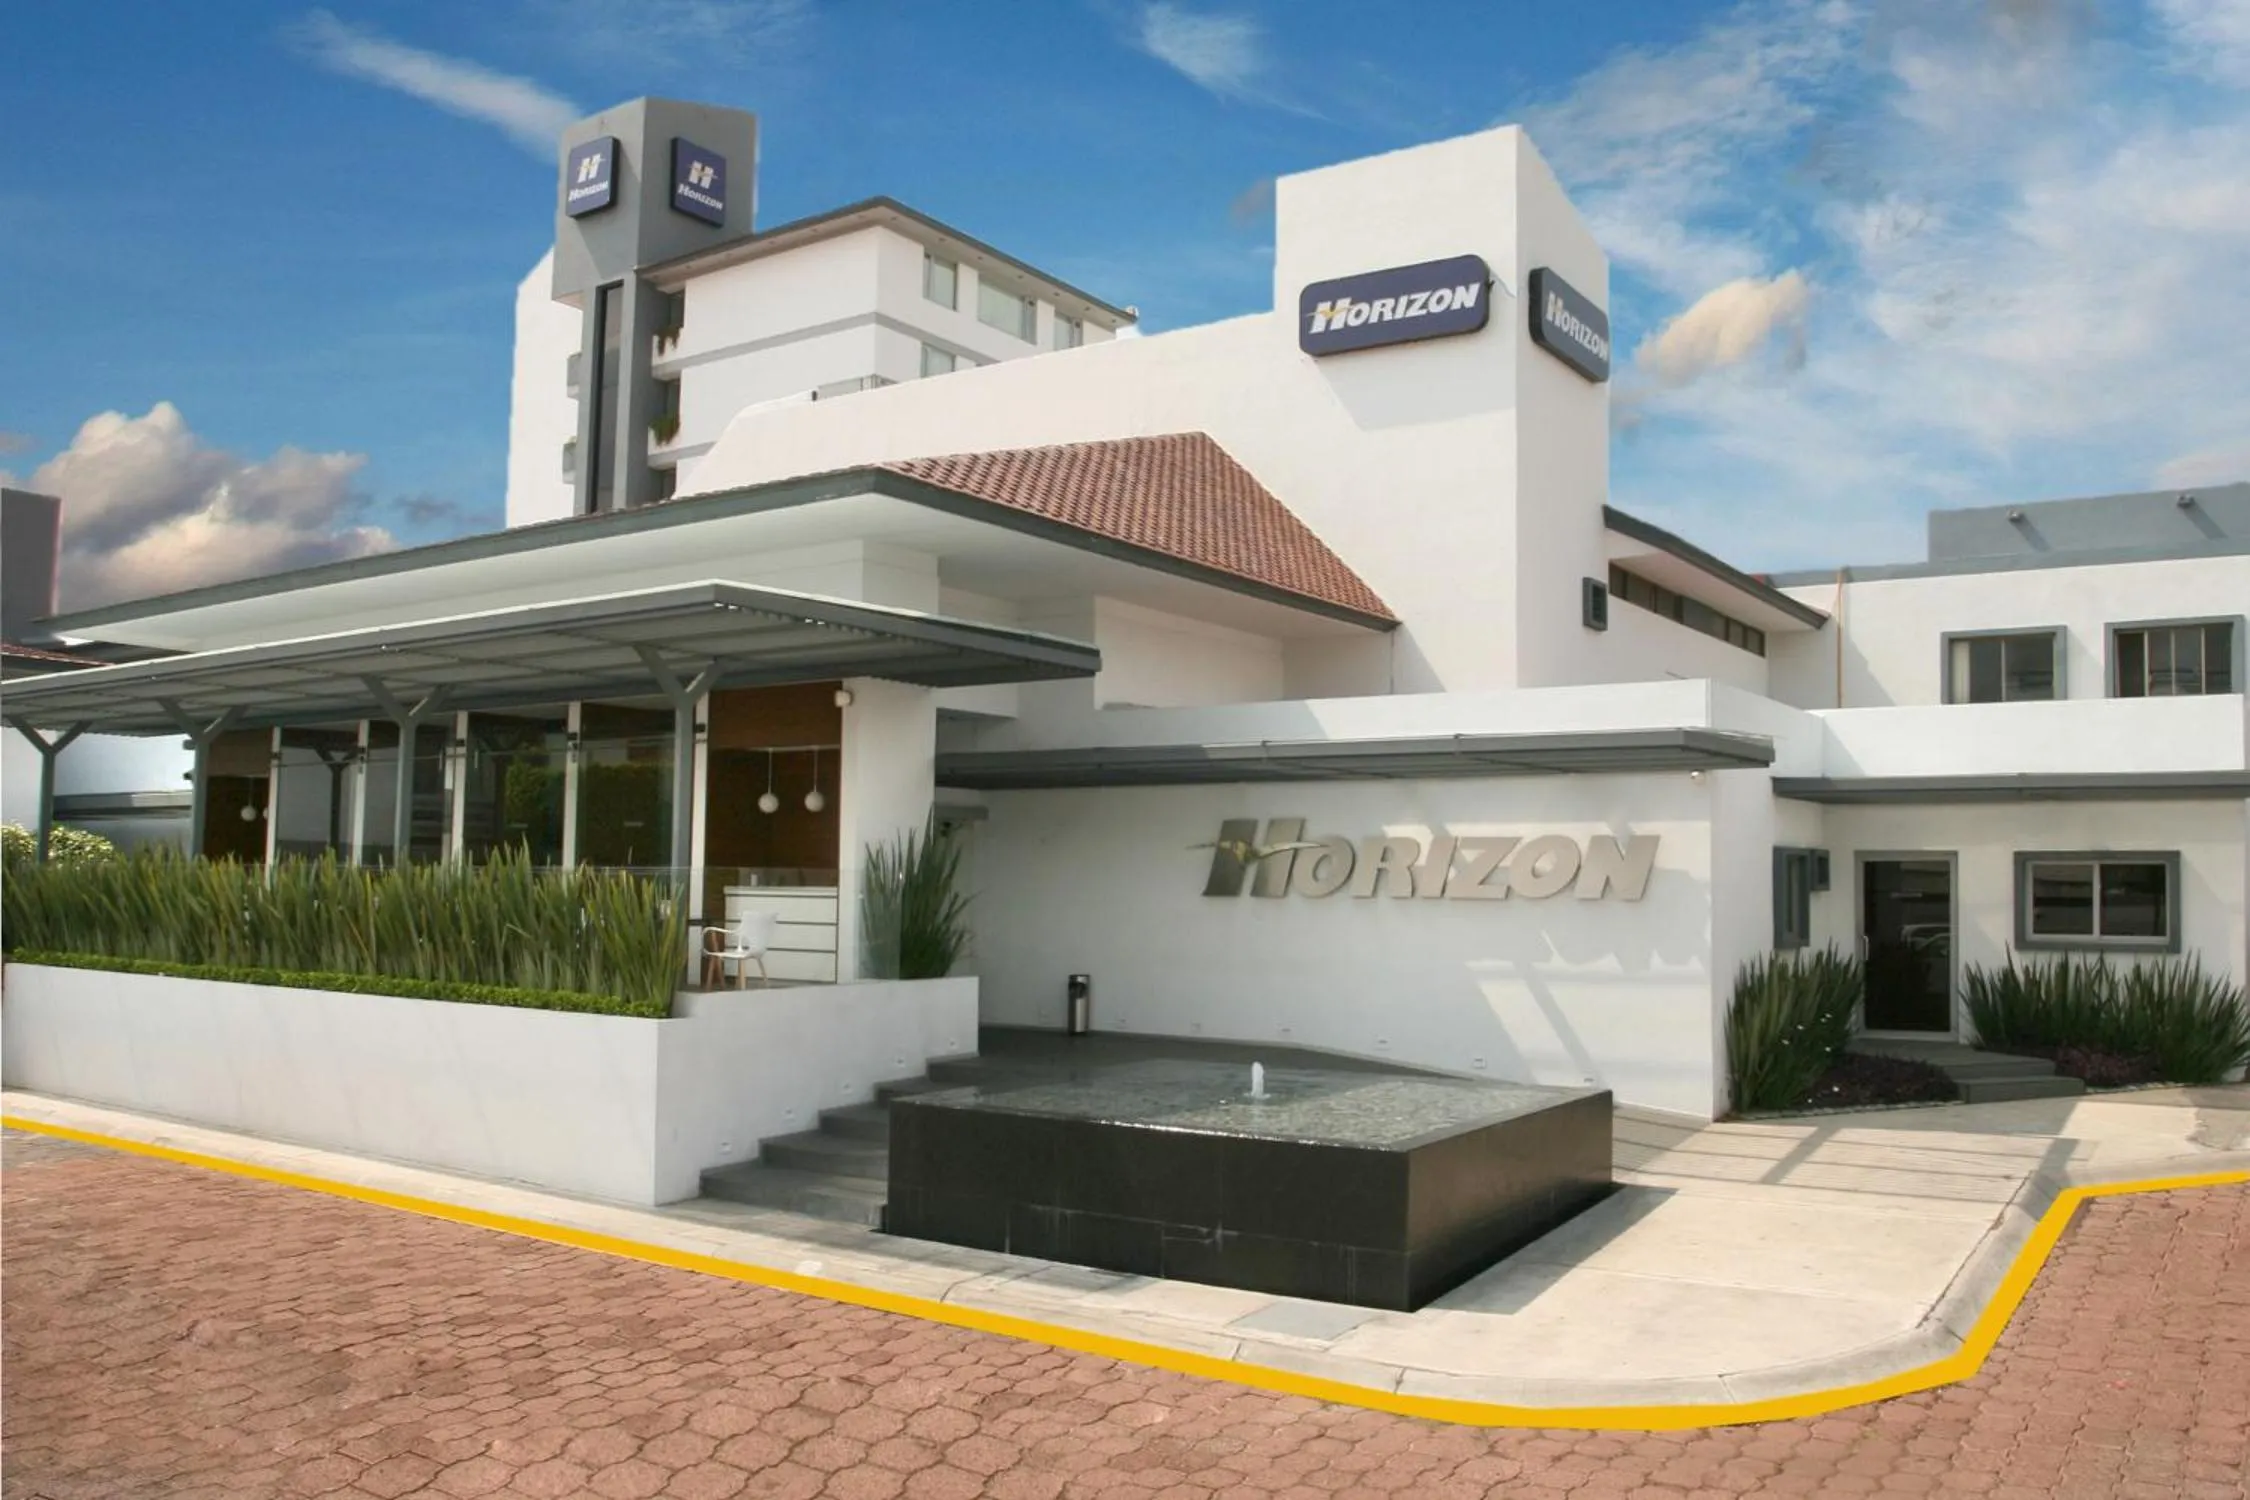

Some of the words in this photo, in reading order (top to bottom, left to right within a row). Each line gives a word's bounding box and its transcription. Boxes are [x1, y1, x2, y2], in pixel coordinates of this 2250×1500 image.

[677, 184, 723, 210] HORIZON
[1309, 282, 1480, 334] HORIZON
[1545, 289, 1609, 361] HORIZON
[1202, 817, 1661, 901] HORIZON
